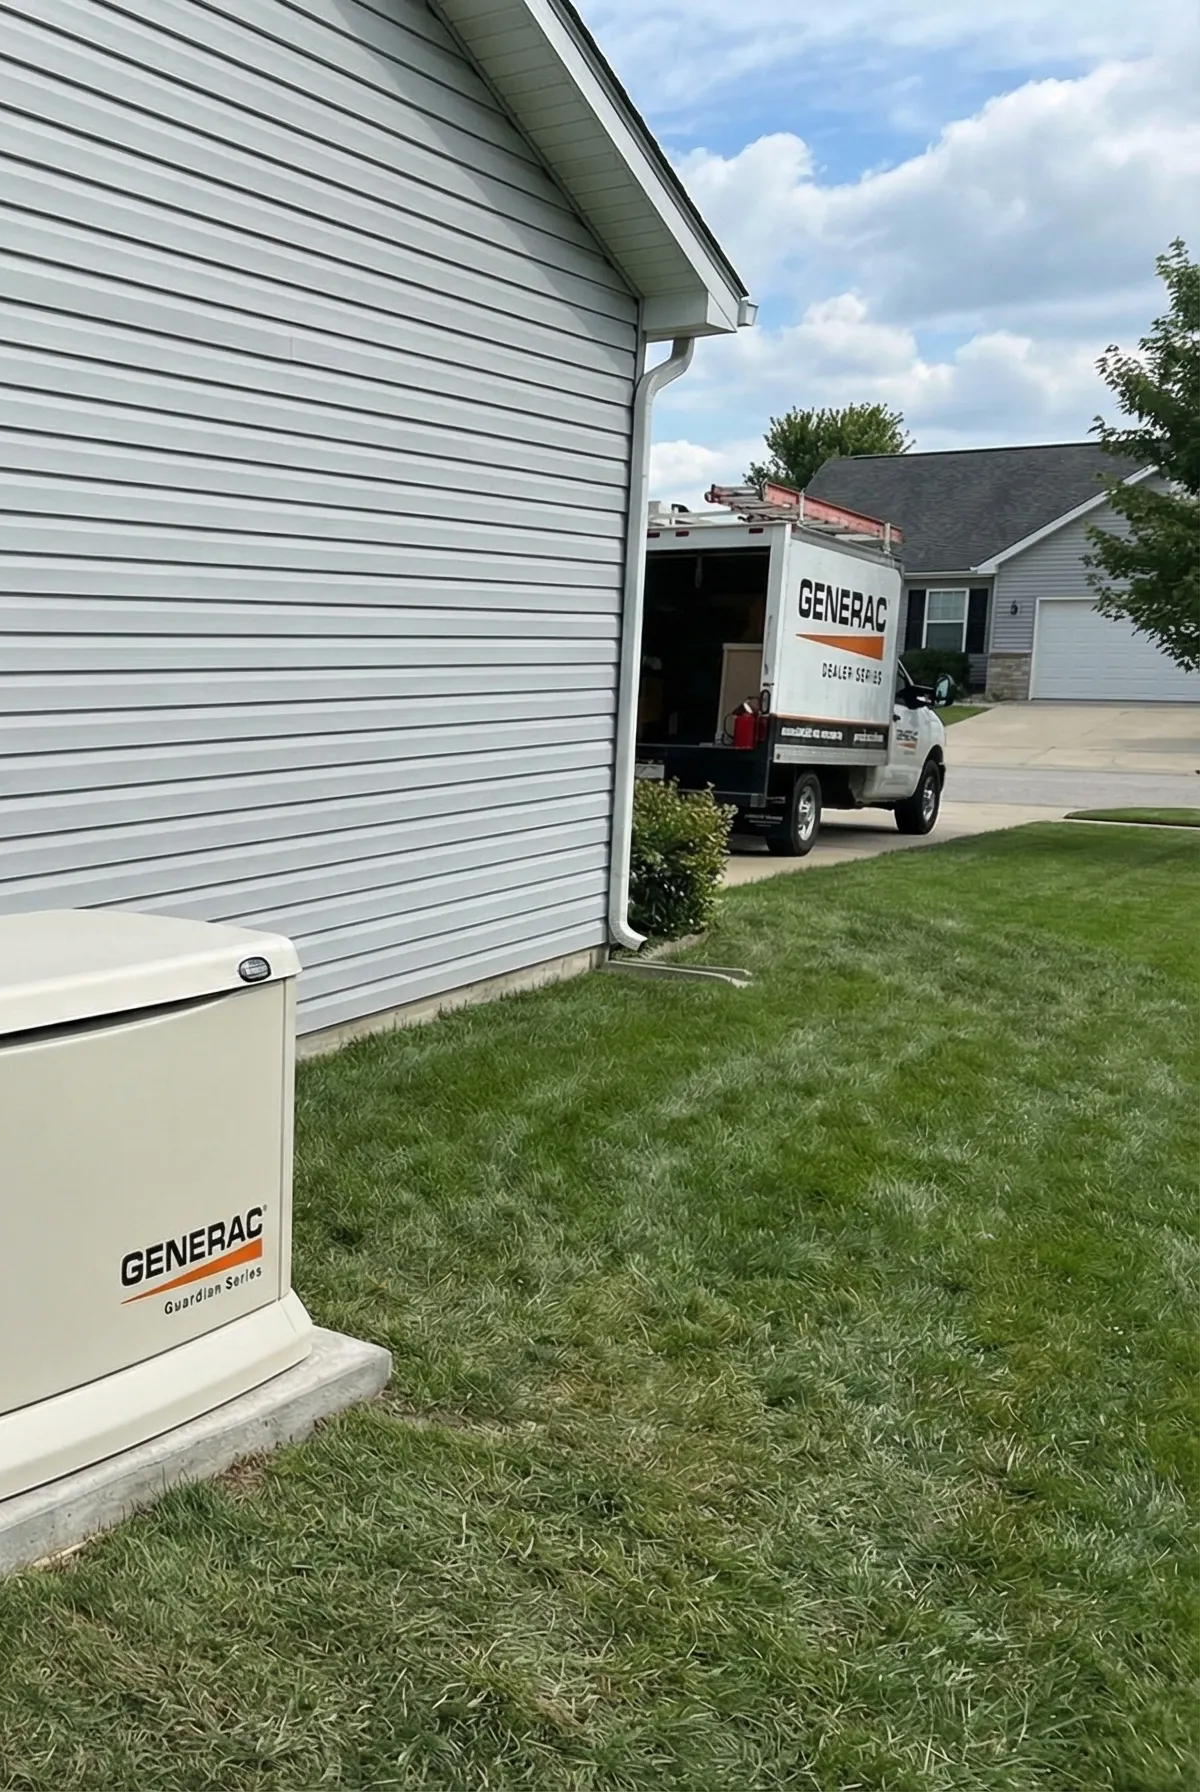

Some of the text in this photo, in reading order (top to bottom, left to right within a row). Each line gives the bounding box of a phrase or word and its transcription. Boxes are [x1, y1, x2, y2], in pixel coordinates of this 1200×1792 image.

[799, 578, 887, 632] GENERAC
[822, 662, 882, 685] DEALER SERES
[121, 1207, 263, 1287] GENERAC
[164, 1267, 262, 1315] Guardian Series
